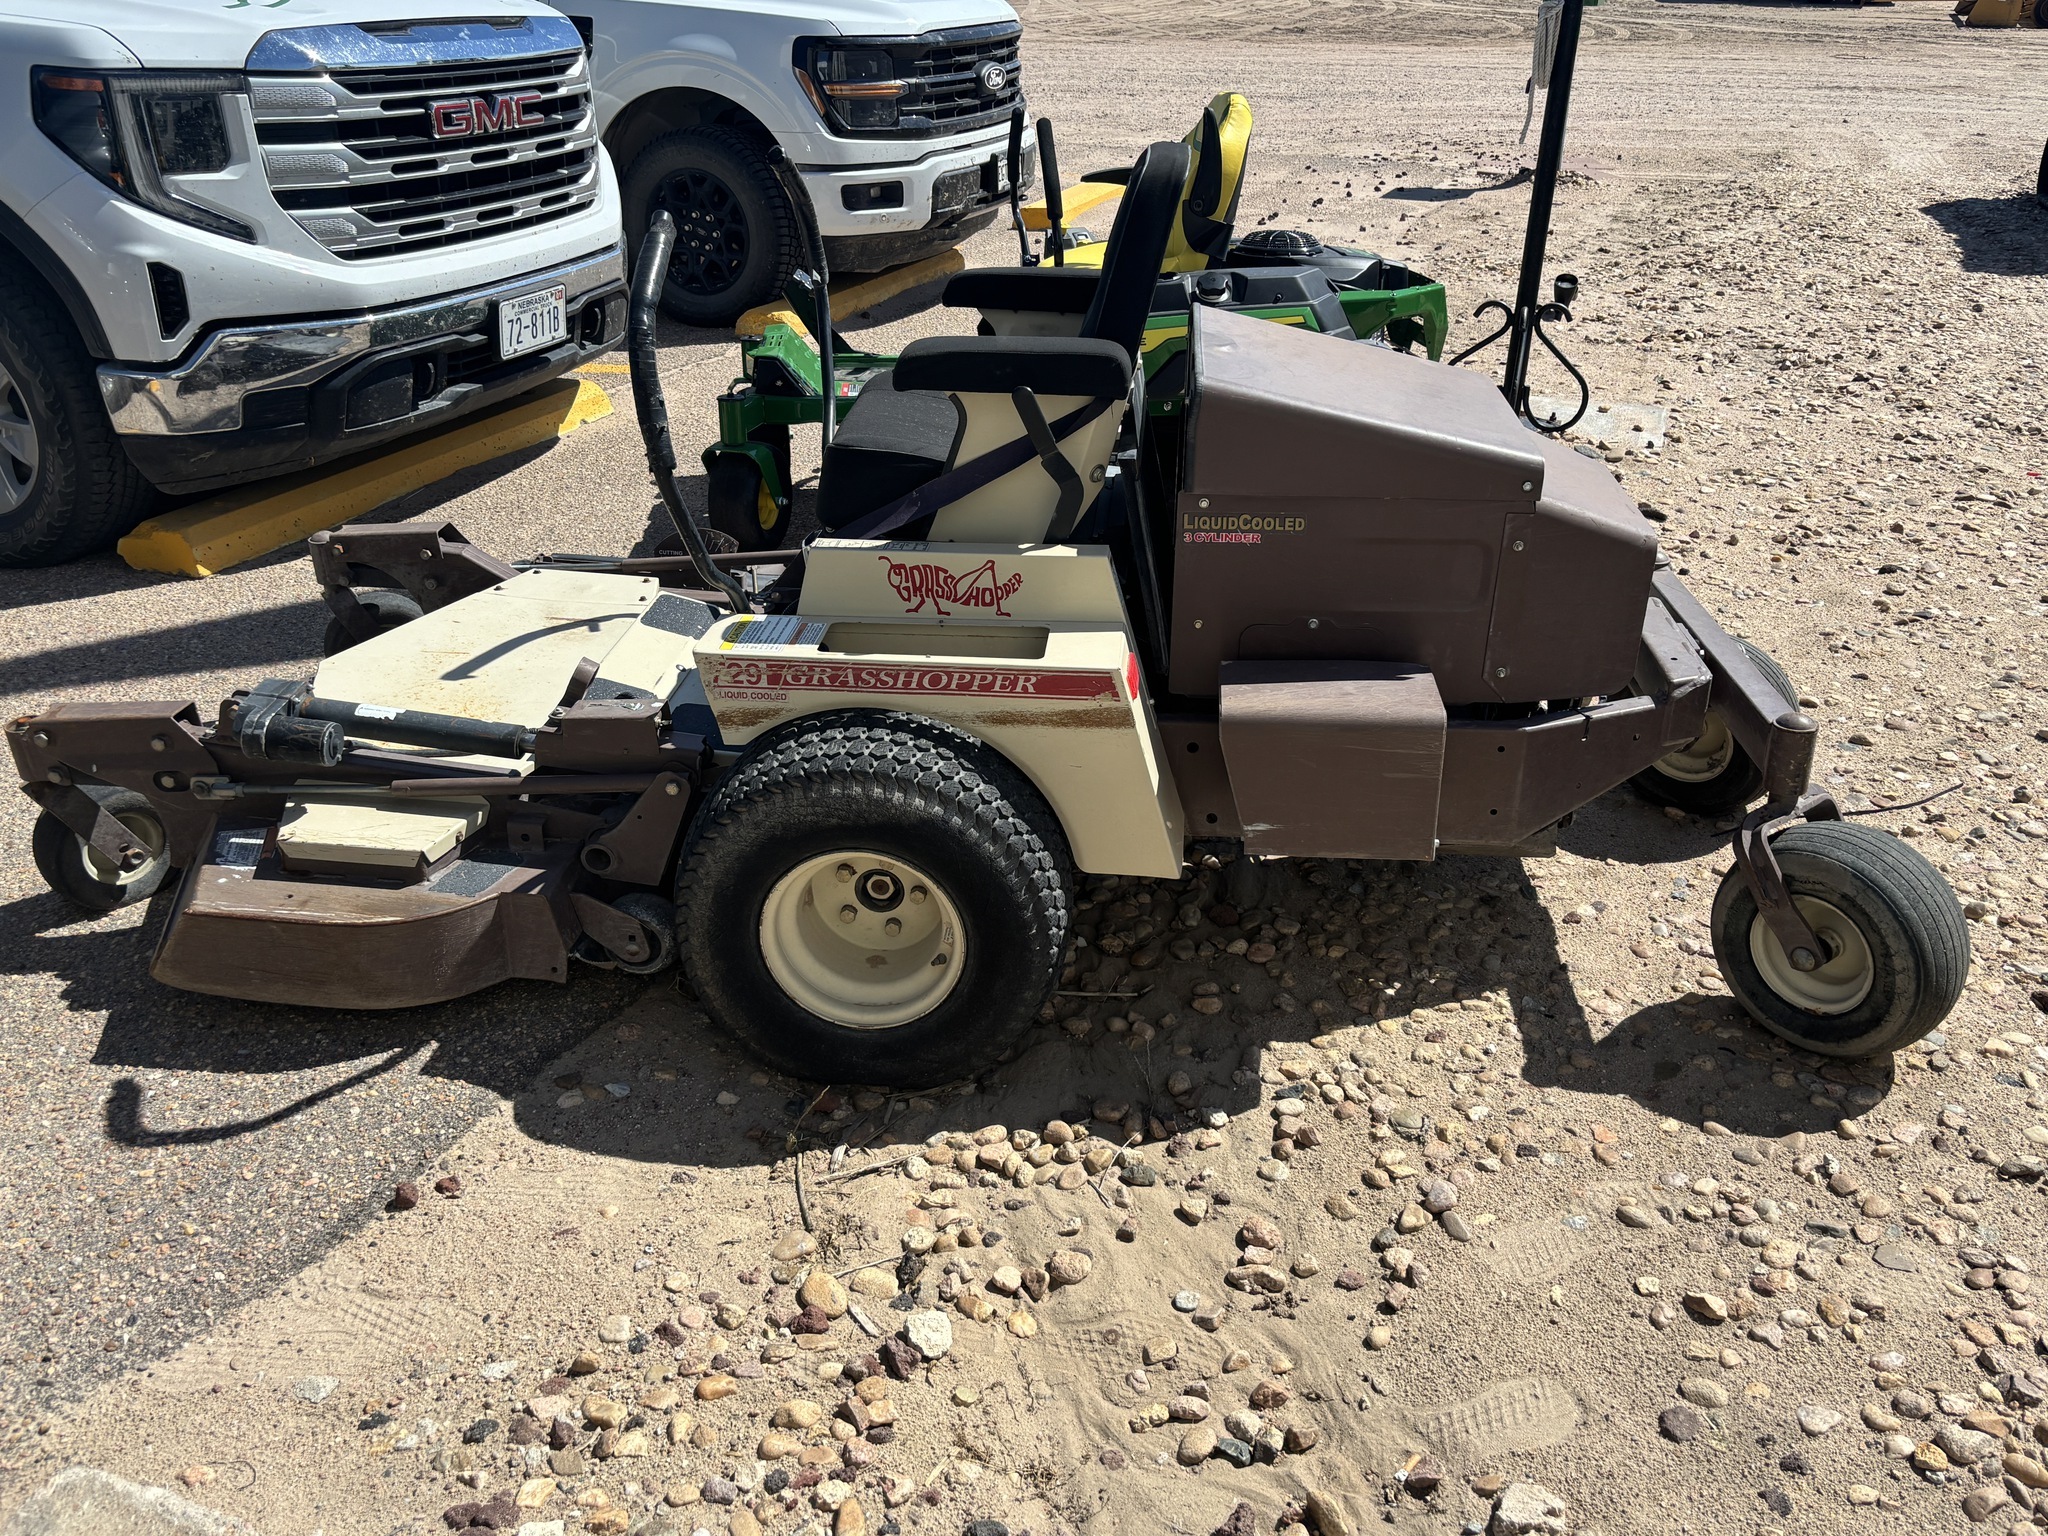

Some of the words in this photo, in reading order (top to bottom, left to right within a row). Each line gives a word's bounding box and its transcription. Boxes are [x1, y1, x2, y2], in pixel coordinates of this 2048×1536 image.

[431, 91, 544, 138] GMC
[514, 306, 539, 316] COMMERCIAL
[517, 294, 549, 309] NEBRASKA
[507, 306, 559, 347] 72-811B
[1183, 532, 1192, 542] 3
[1194, 532, 1261, 543] CYLINDER
[882, 558, 1024, 617] GRASSHOPPER
[785, 662, 1037, 693] GRASSHOPPER
[719, 690, 748, 700] LIQUID
[750, 692, 787, 701] COOLED
